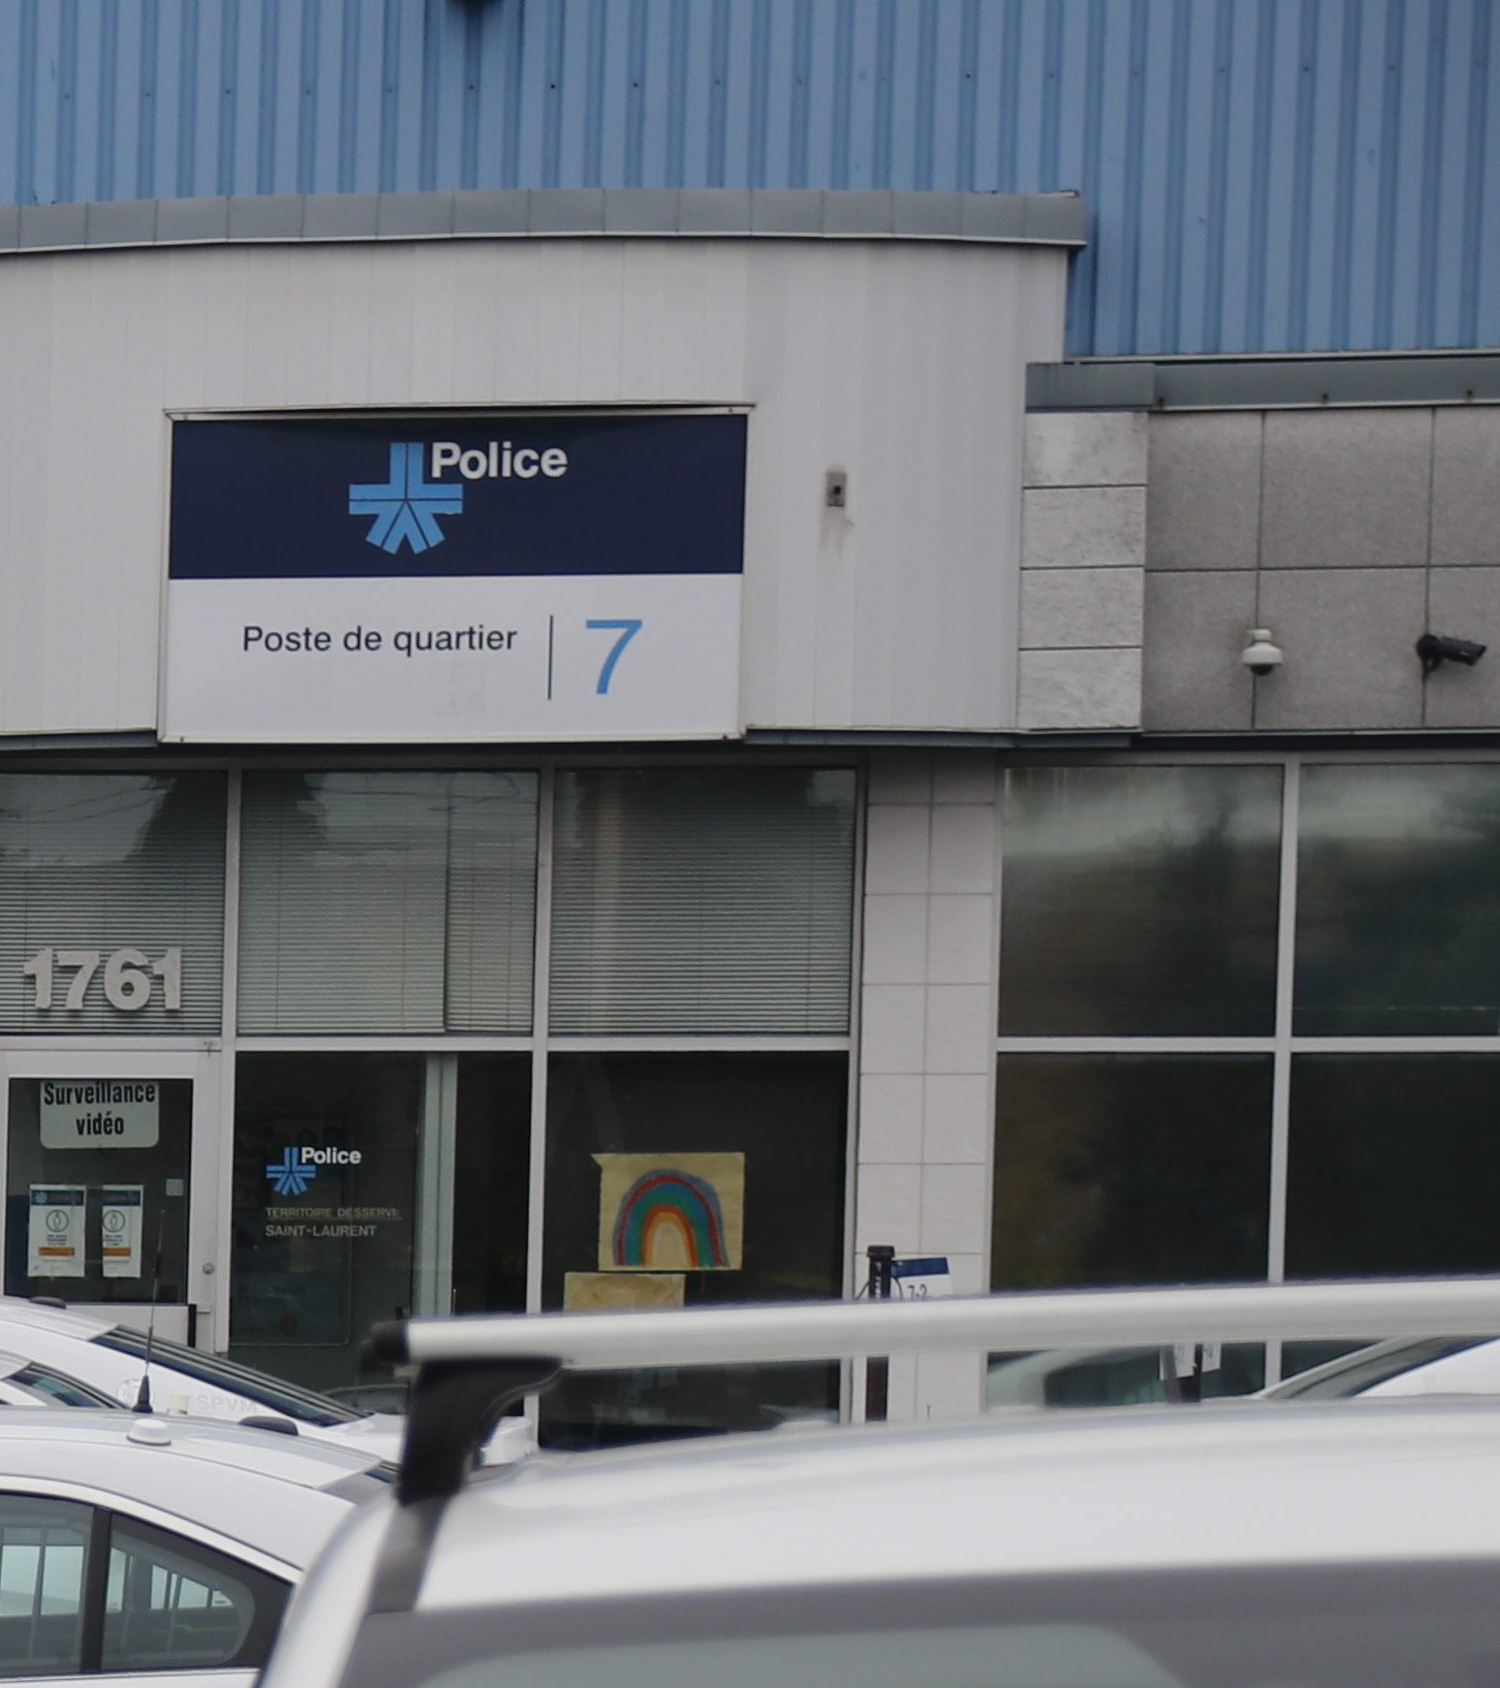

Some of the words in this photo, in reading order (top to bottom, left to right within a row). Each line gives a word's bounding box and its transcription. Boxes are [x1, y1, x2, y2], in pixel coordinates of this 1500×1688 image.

[431, 441, 568, 479] Police
[242, 625, 332, 653] Poste
[343, 625, 383, 652] de
[393, 624, 518, 658] quartier
[585, 618, 644, 695] 7
[23, 947, 183, 1011] 1761
[43, 1081, 156, 1106] Surveillance
[76, 1110, 125, 1136] vidéo
[301, 1146, 362, 1165] Police
[265, 1206, 332, 1218] TERRITOIRE
[265, 1224, 378, 1237] SAINT-LAURENT
